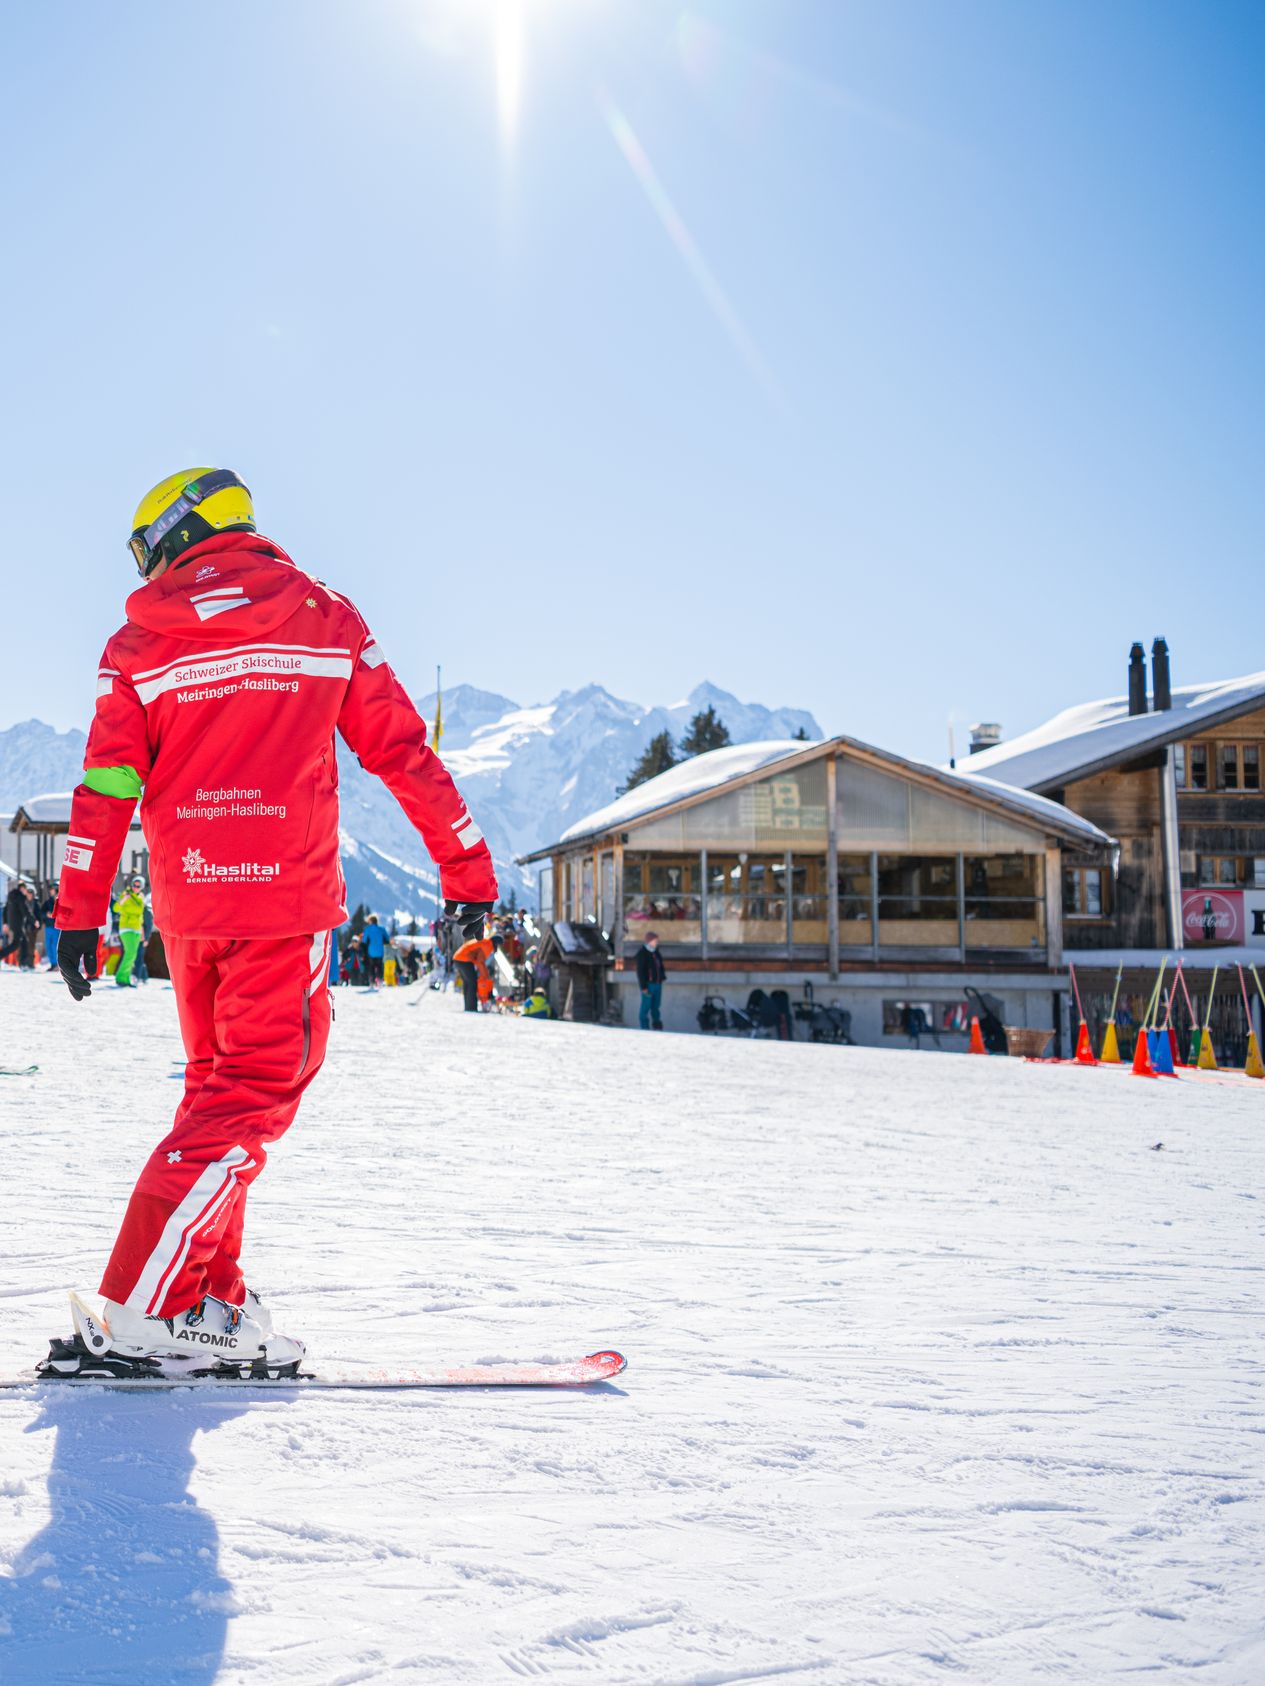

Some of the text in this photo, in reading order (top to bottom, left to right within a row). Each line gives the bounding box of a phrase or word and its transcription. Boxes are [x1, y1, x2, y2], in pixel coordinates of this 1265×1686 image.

[175, 656, 302, 682] Schweizer Skischule
[176, 677, 299, 704] Meiringen-Hasliberg
[196, 787, 262, 803] Bergbahnen
[176, 803, 287, 820] Meiringen-Hasliberg
[203, 863, 280, 876] Haslital
[176, 1329, 238, 1349] ATOMIC
